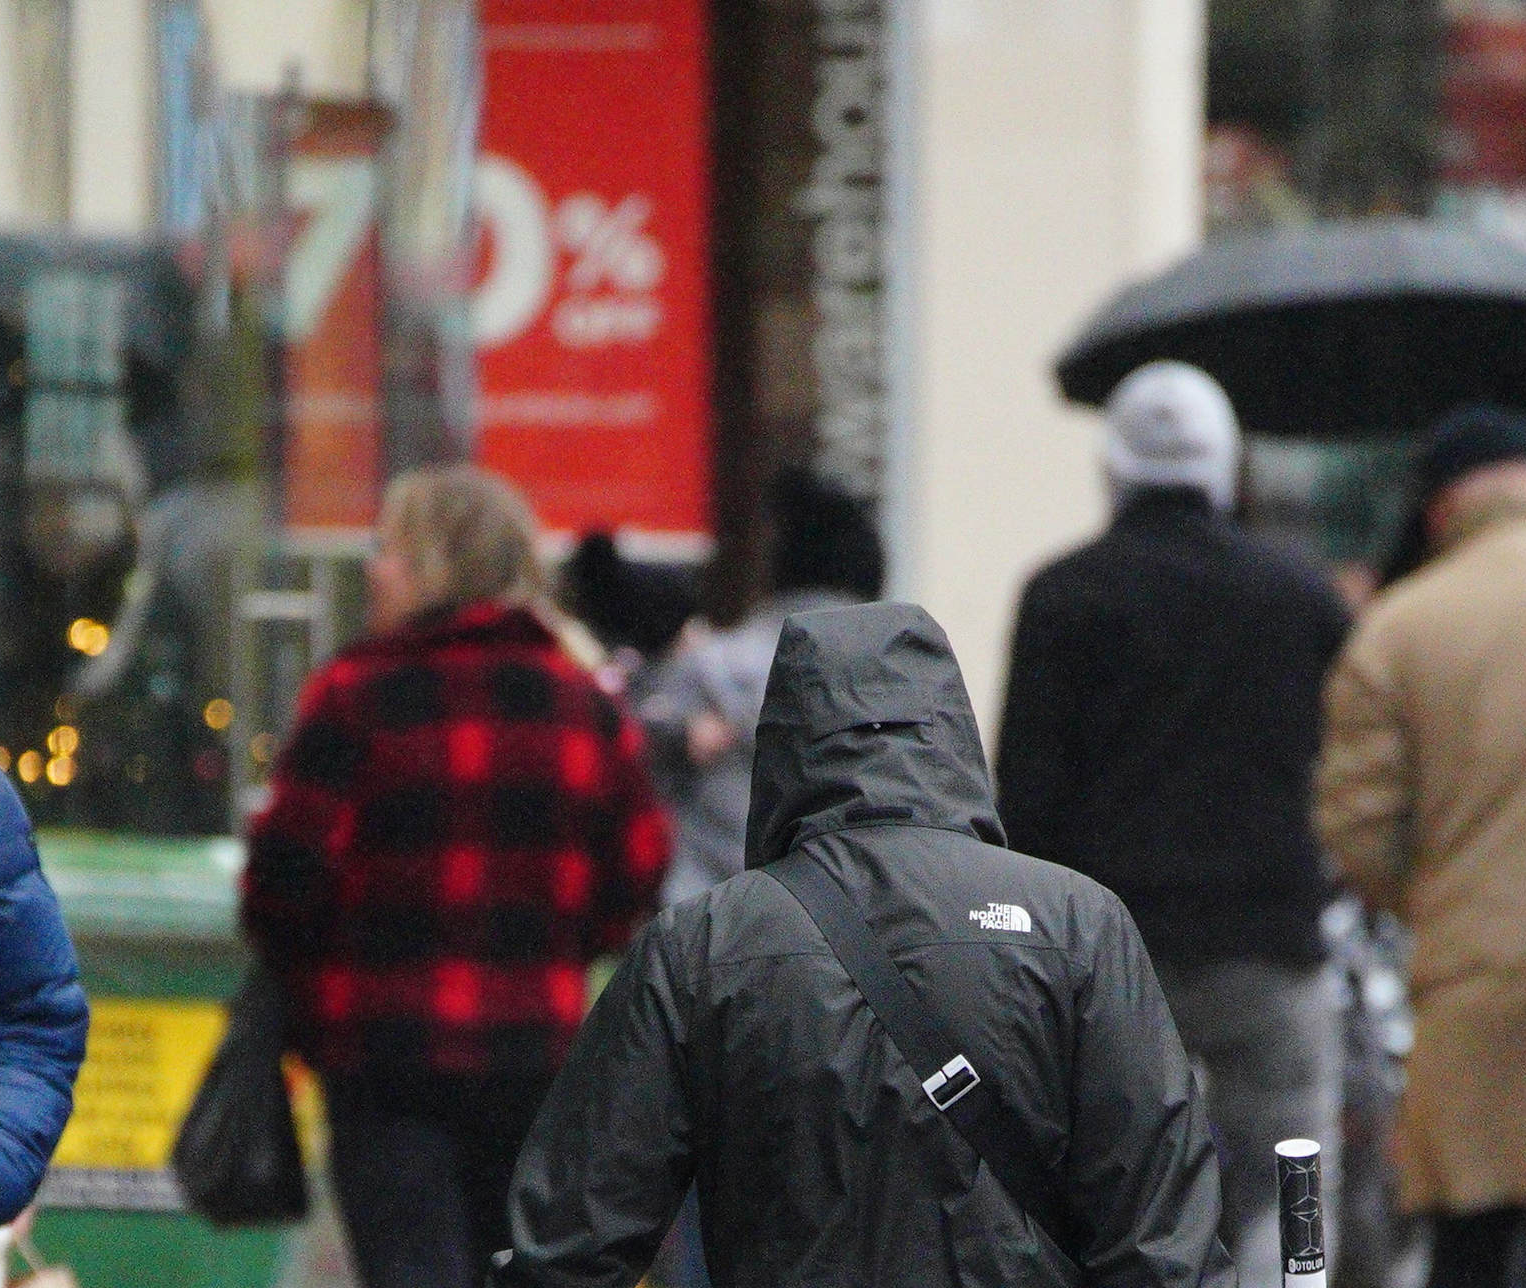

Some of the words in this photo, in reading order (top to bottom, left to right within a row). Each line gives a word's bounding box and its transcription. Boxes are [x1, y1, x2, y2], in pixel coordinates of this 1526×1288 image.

[986, 902, 1011, 914] THE
[968, 910, 1011, 923] NORTH
[979, 919, 1011, 931] FACE
